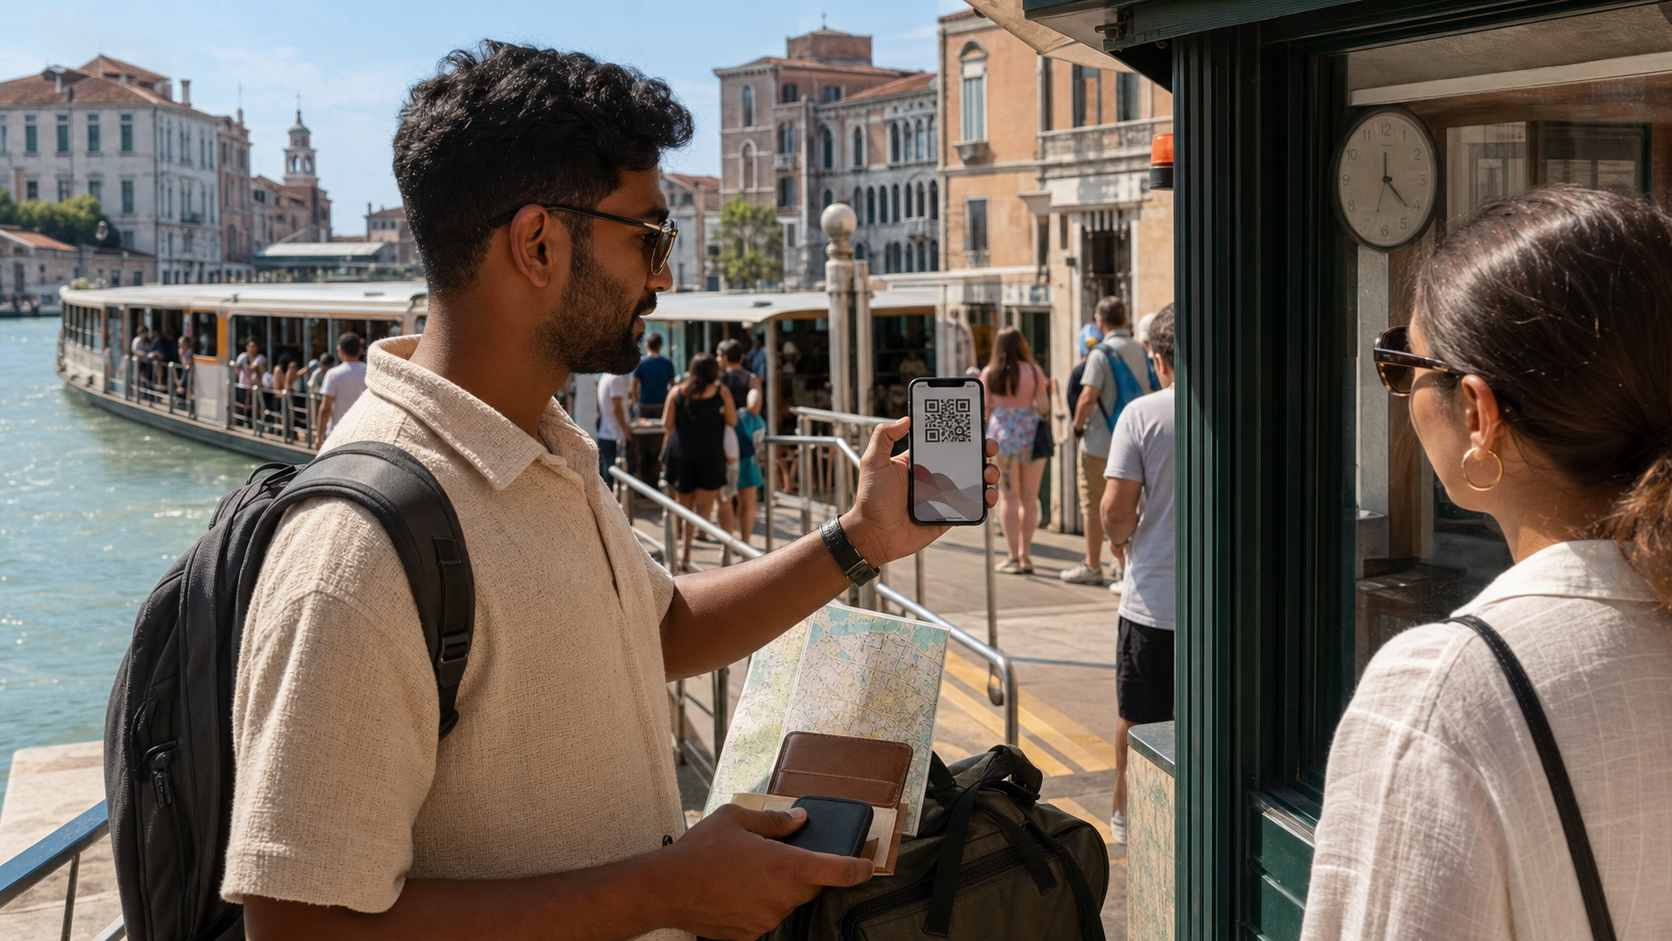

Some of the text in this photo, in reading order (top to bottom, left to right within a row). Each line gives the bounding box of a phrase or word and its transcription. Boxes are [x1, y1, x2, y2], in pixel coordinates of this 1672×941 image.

[1363, 129, 1371, 141] 11
[1381, 124, 1391, 137] 12
[1402, 130, 1406, 141] 1
[1347, 148, 1357, 161] 10
[1414, 148, 1421, 160] 2
[1342, 174, 1350, 186] 9
[1419, 174, 1426, 187] 3
[1348, 199, 1355, 212] 8
[1413, 200, 1421, 212] 4
[1400, 218, 1407, 230] 5
[1381, 225, 1389, 237] 6
